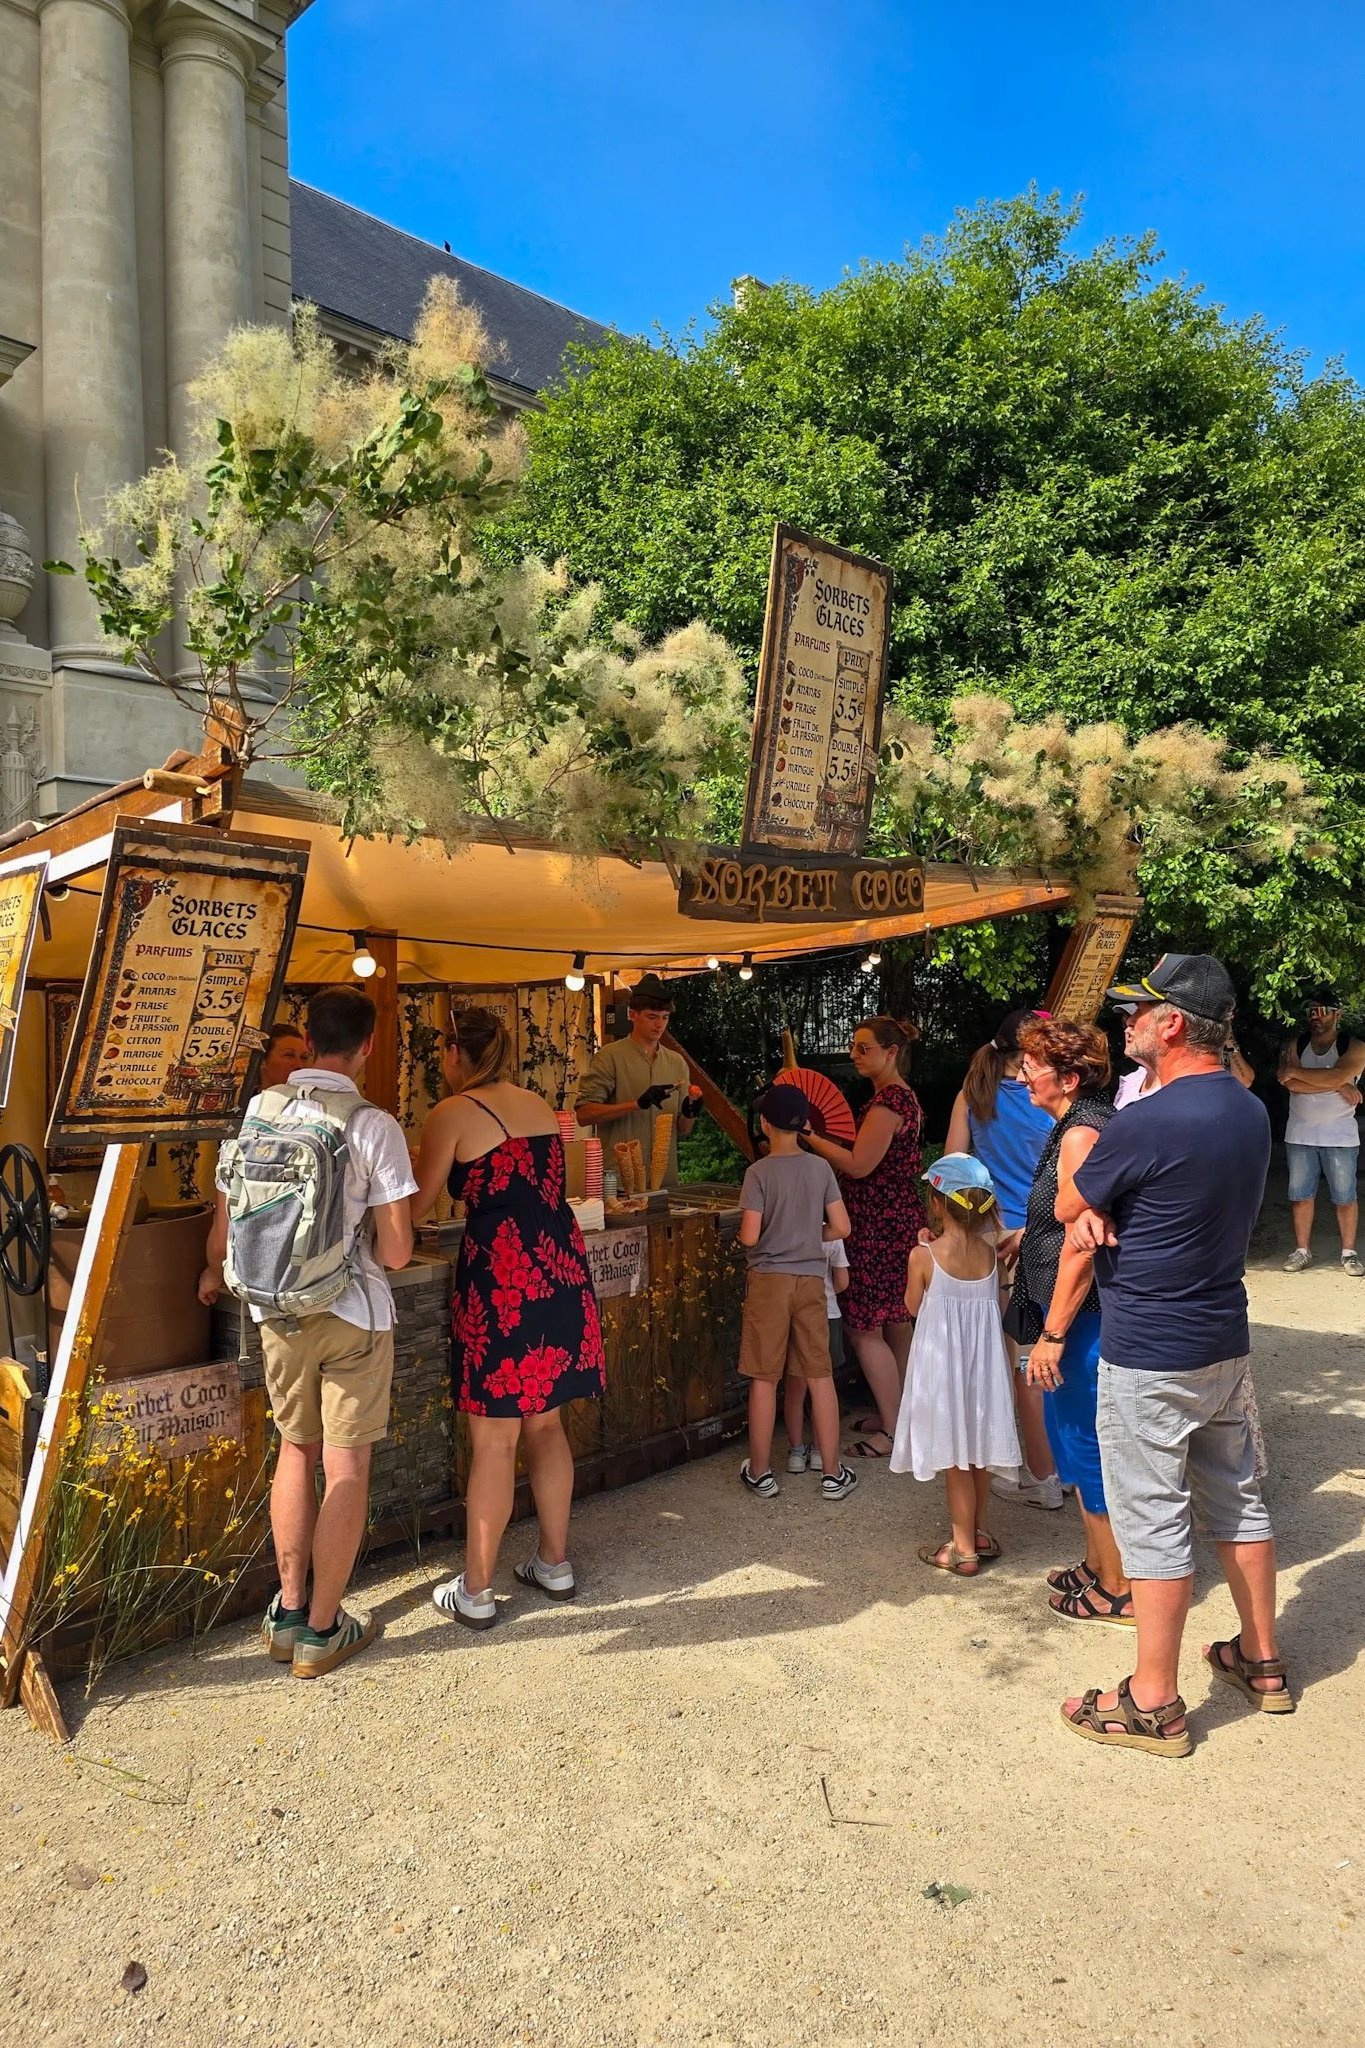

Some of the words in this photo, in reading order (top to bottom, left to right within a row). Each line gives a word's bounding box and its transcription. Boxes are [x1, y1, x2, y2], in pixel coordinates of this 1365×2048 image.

[813, 578, 870, 616] SORBETS
[817, 604, 865, 638] GLACES
[794, 631, 830, 654] PARFUMS
[845, 651, 864, 668] PRIX
[799, 667, 814, 679] COCO
[796, 684, 821, 699] ANANAS
[838, 677, 865, 694] SIMPLE
[794, 703, 817, 716] FRAISE
[835, 694, 865, 721] 3.5€
[792, 719, 811, 731] FRUIT
[812, 723, 819, 732] DE
[792, 730, 799, 739] LA
[800, 731, 824, 744] PASSION
[790, 746, 813, 759] CITRON
[831, 739, 859, 755] DOUBLE
[788, 763, 815, 777] MANGUE
[828, 756, 858, 782] 5.5€
[786, 779, 811, 793] VANILLE
[783, 797, 815, 811] CHOCOLAT
[690, 857, 839, 923] SORBET
[852, 868, 924, 912] COCO
[168, 895, 258, 920] SORBETS
[172, 917, 248, 939] GLACES
[135, 944, 193, 957] PARFUMS
[215, 953, 245, 965] PRIX
[142, 972, 165, 981] COCO
[205, 975, 245, 986] SIMPLE
[138, 987, 177, 996] ANANAS
[198, 988, 244, 1009] 3.5€
[135, 1002, 169, 1010] FRAISE
[132, 1014, 160, 1023] FRUIT
[142, 1024, 179, 1032] PASSION
[192, 1026, 233, 1036] DOUBLE
[126, 1036, 161, 1045] CITRON
[123, 1050, 164, 1059] MANGUE
[185, 1039, 230, 1058] 5.5€
[119, 1064, 157, 1072] VANILLE
[115, 1077, 162, 1086] CHOCOLAT
[587, 1244, 610, 1263] rbet
[613, 1241, 640, 1259] Coco
[181, 1382, 227, 1408] Coco
